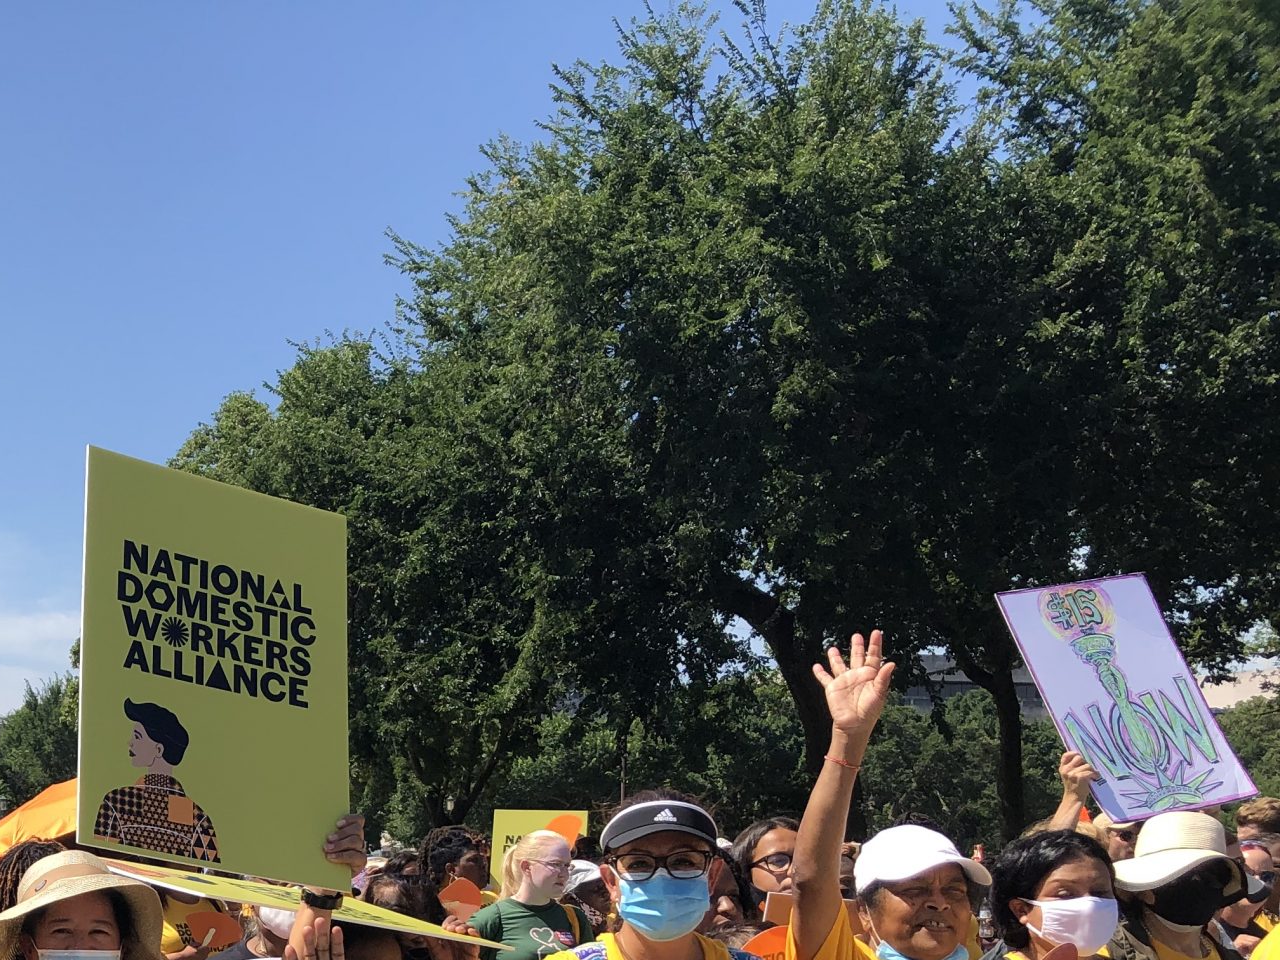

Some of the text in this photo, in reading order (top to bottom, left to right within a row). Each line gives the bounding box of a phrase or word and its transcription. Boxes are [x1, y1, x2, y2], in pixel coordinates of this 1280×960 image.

[117, 570, 317, 646] DOMESTIC
[123, 539, 312, 615] NATIONAL
[122, 604, 312, 677] WORKERS
[122, 639, 309, 709] ALLIANCE
[1063, 674, 1220, 786] NOW
